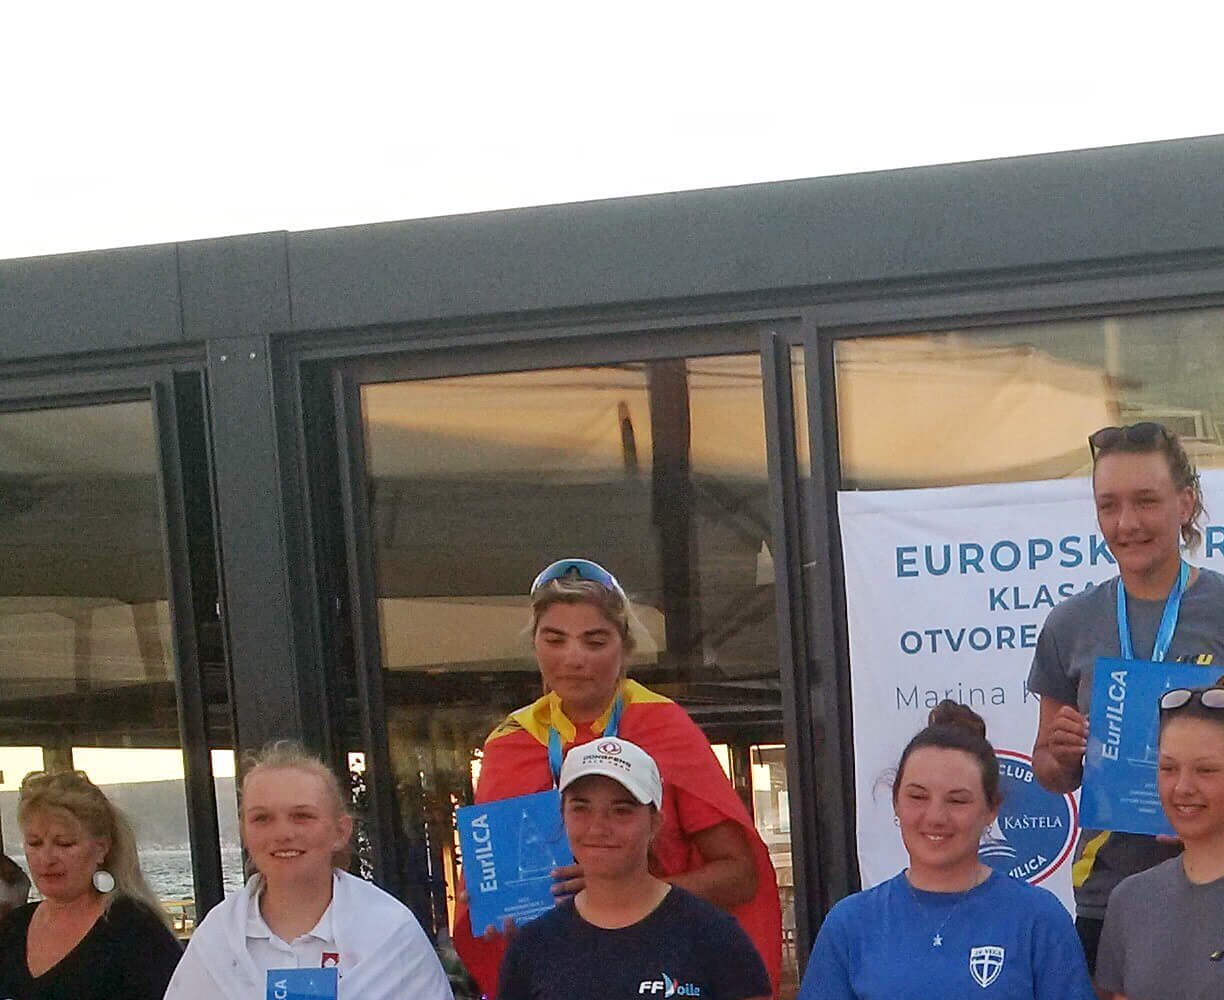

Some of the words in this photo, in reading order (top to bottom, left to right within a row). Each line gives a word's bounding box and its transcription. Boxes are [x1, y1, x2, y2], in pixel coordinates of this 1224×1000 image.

[895, 534, 1117, 578] EUROPSK
[900, 624, 1037, 655] OTVORE
[896, 682, 1005, 710] Marina
[998, 764, 1034, 783] CLUB
[1004, 815, 1062, 830] KAŠTELA
[1008, 855, 1047, 878] ILICA
